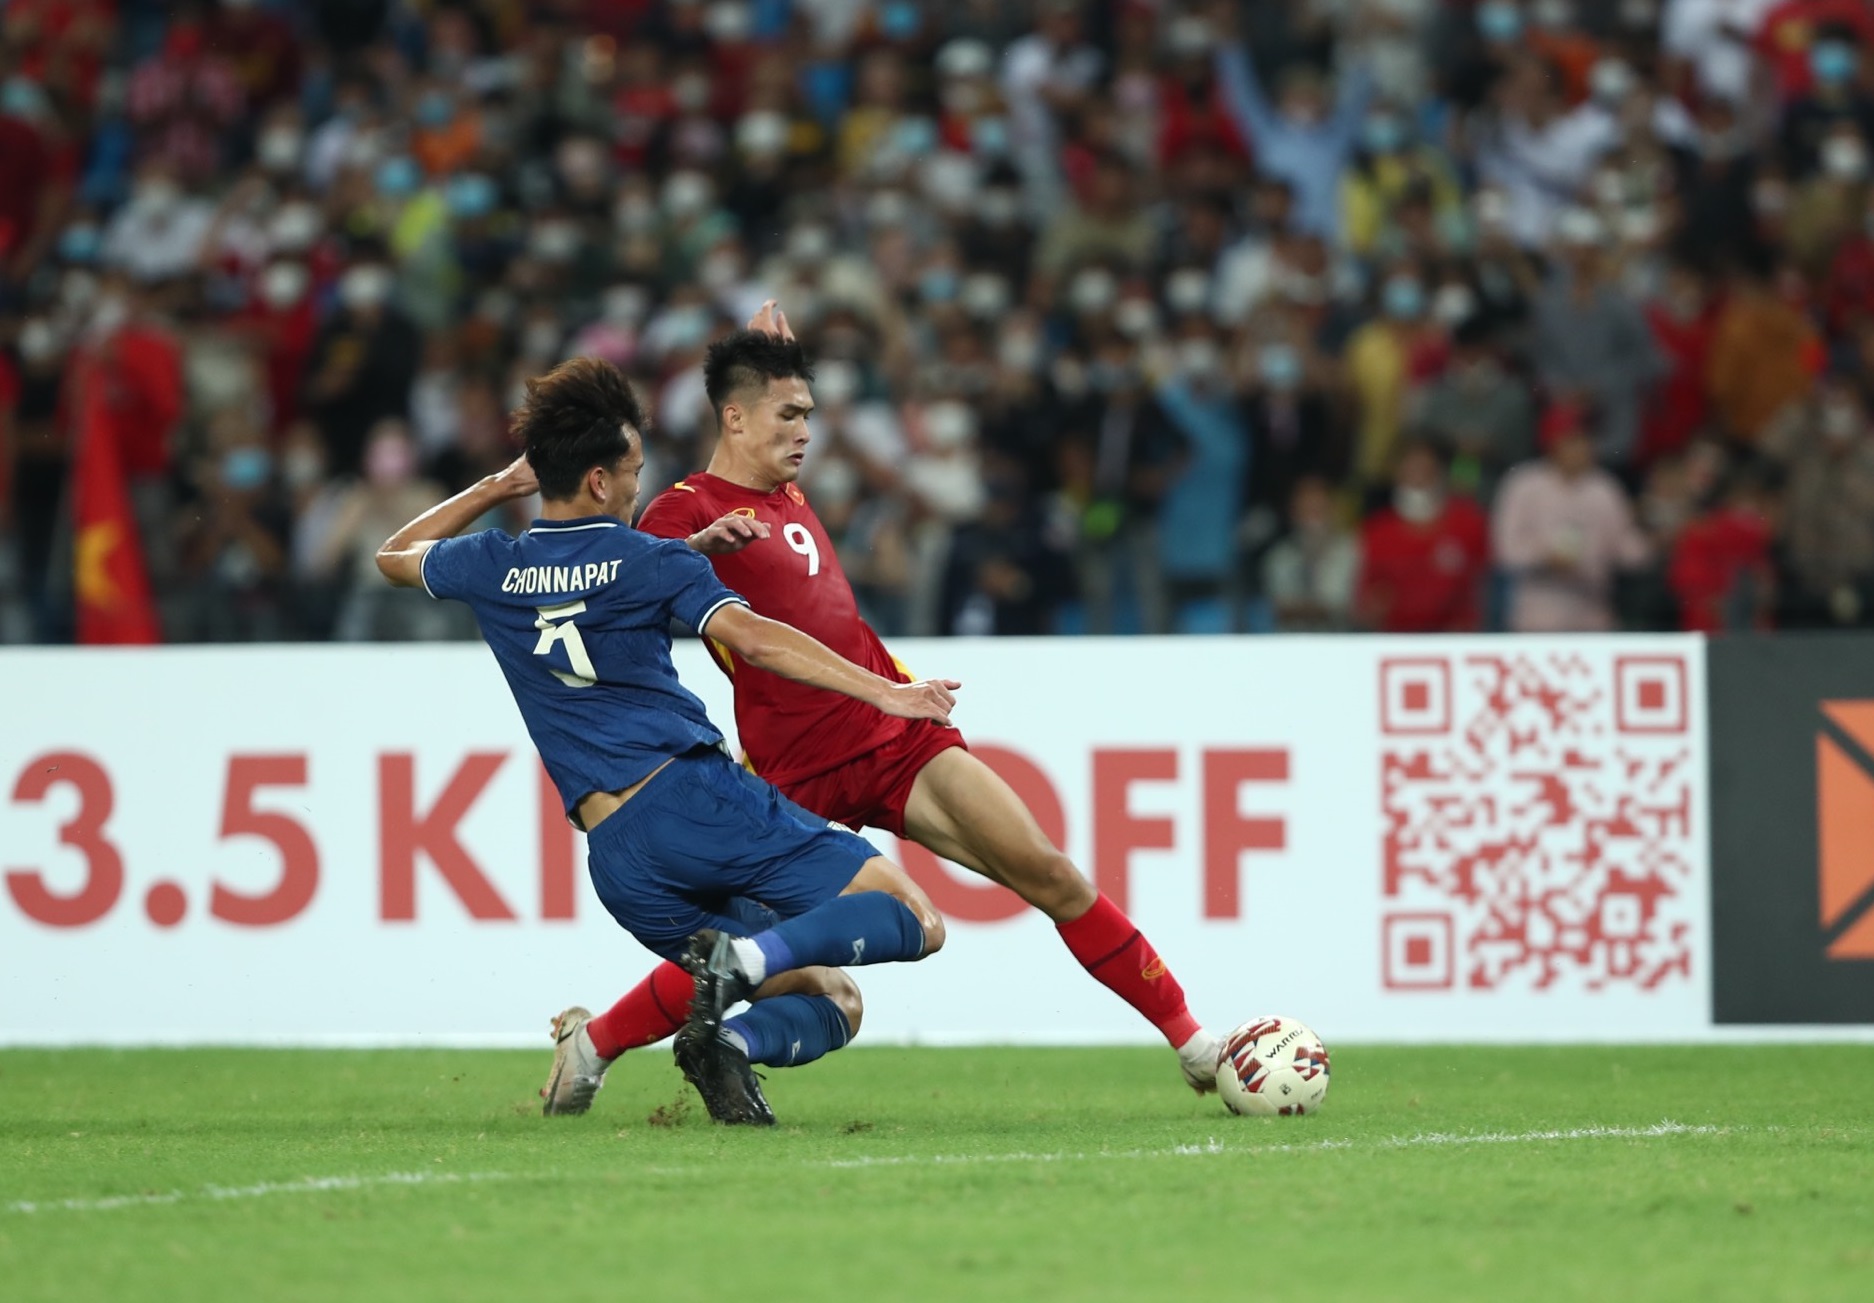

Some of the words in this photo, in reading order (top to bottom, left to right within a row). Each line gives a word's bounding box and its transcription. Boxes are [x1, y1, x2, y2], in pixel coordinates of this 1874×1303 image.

[501, 559, 623, 594] CHONNAPAT
[782, 522, 820, 577] 9
[533, 600, 598, 688] 5
[5, 747, 322, 929] 3.5
[377, 747, 578, 923] KI
[895, 741, 1291, 924] OFF
